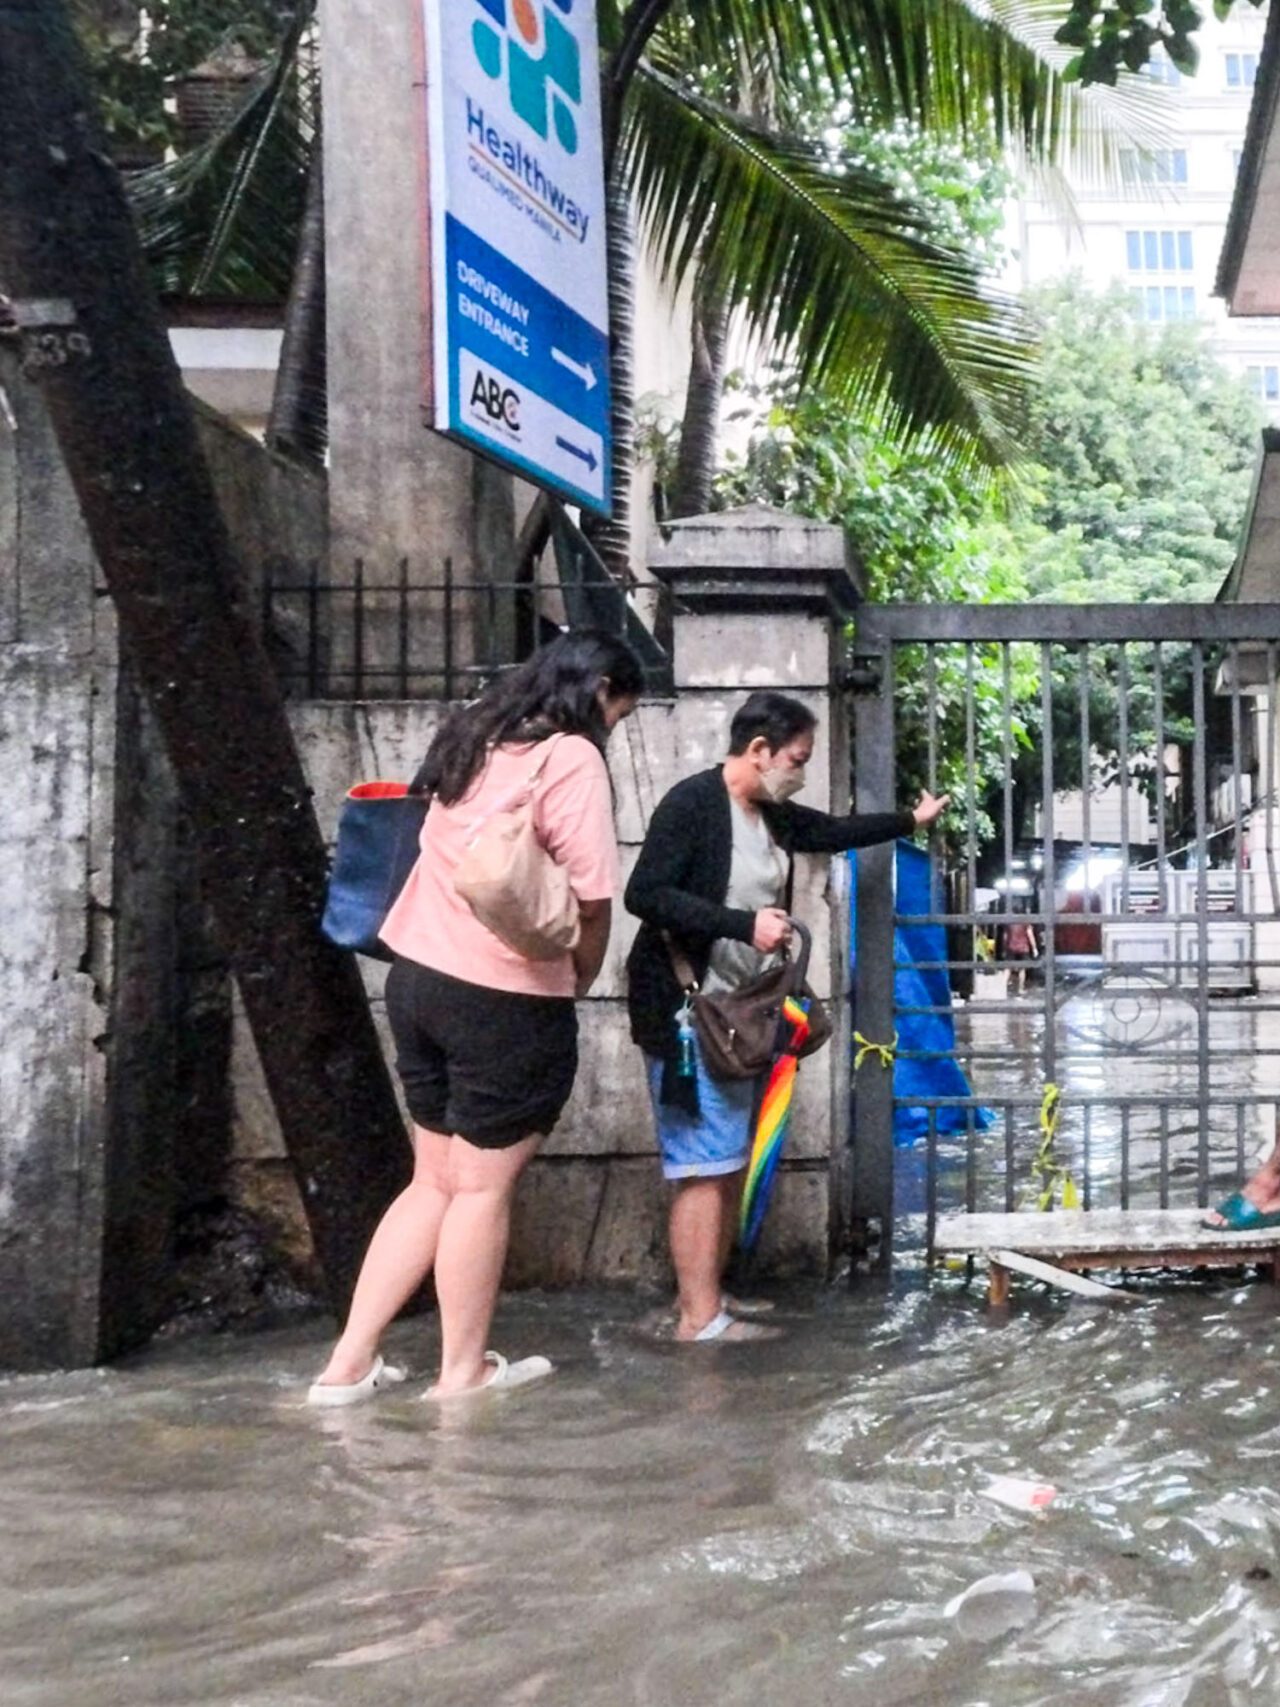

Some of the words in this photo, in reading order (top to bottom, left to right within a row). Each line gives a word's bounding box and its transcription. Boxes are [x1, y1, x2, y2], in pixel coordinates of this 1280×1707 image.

[466, 96, 590, 244] Healthway
[457, 259, 530, 327] DRIVEWAY
[458, 293, 530, 357] ENTRANCE
[470, 370, 520, 431] ABC
